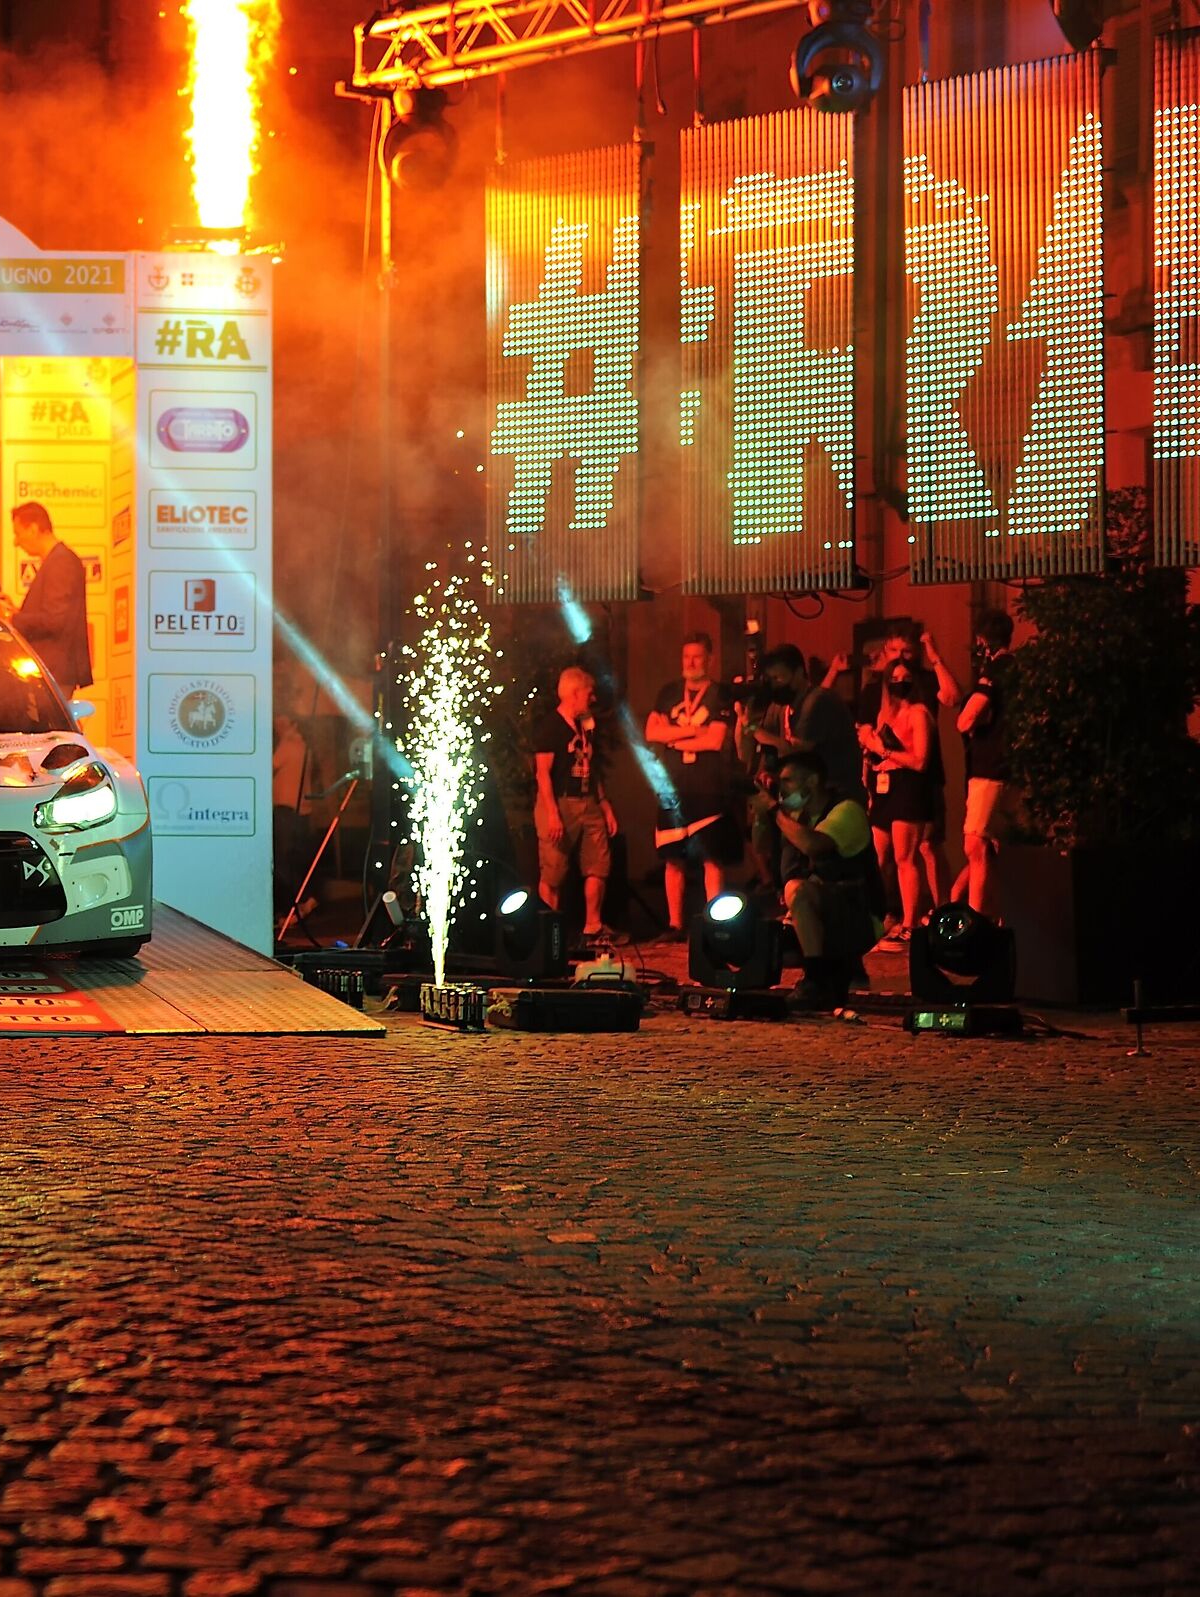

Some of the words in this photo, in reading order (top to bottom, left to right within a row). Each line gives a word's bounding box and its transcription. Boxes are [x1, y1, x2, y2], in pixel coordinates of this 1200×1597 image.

[64, 265, 114, 285] 2021
[155, 320, 251, 361] #RA
[56, 421, 92, 439] plus
[156, 504, 249, 525] ELIOTEC
[154, 614, 238, 631] PELETTO
[188, 807, 249, 823] integra
[110, 909, 144, 927] OMP
